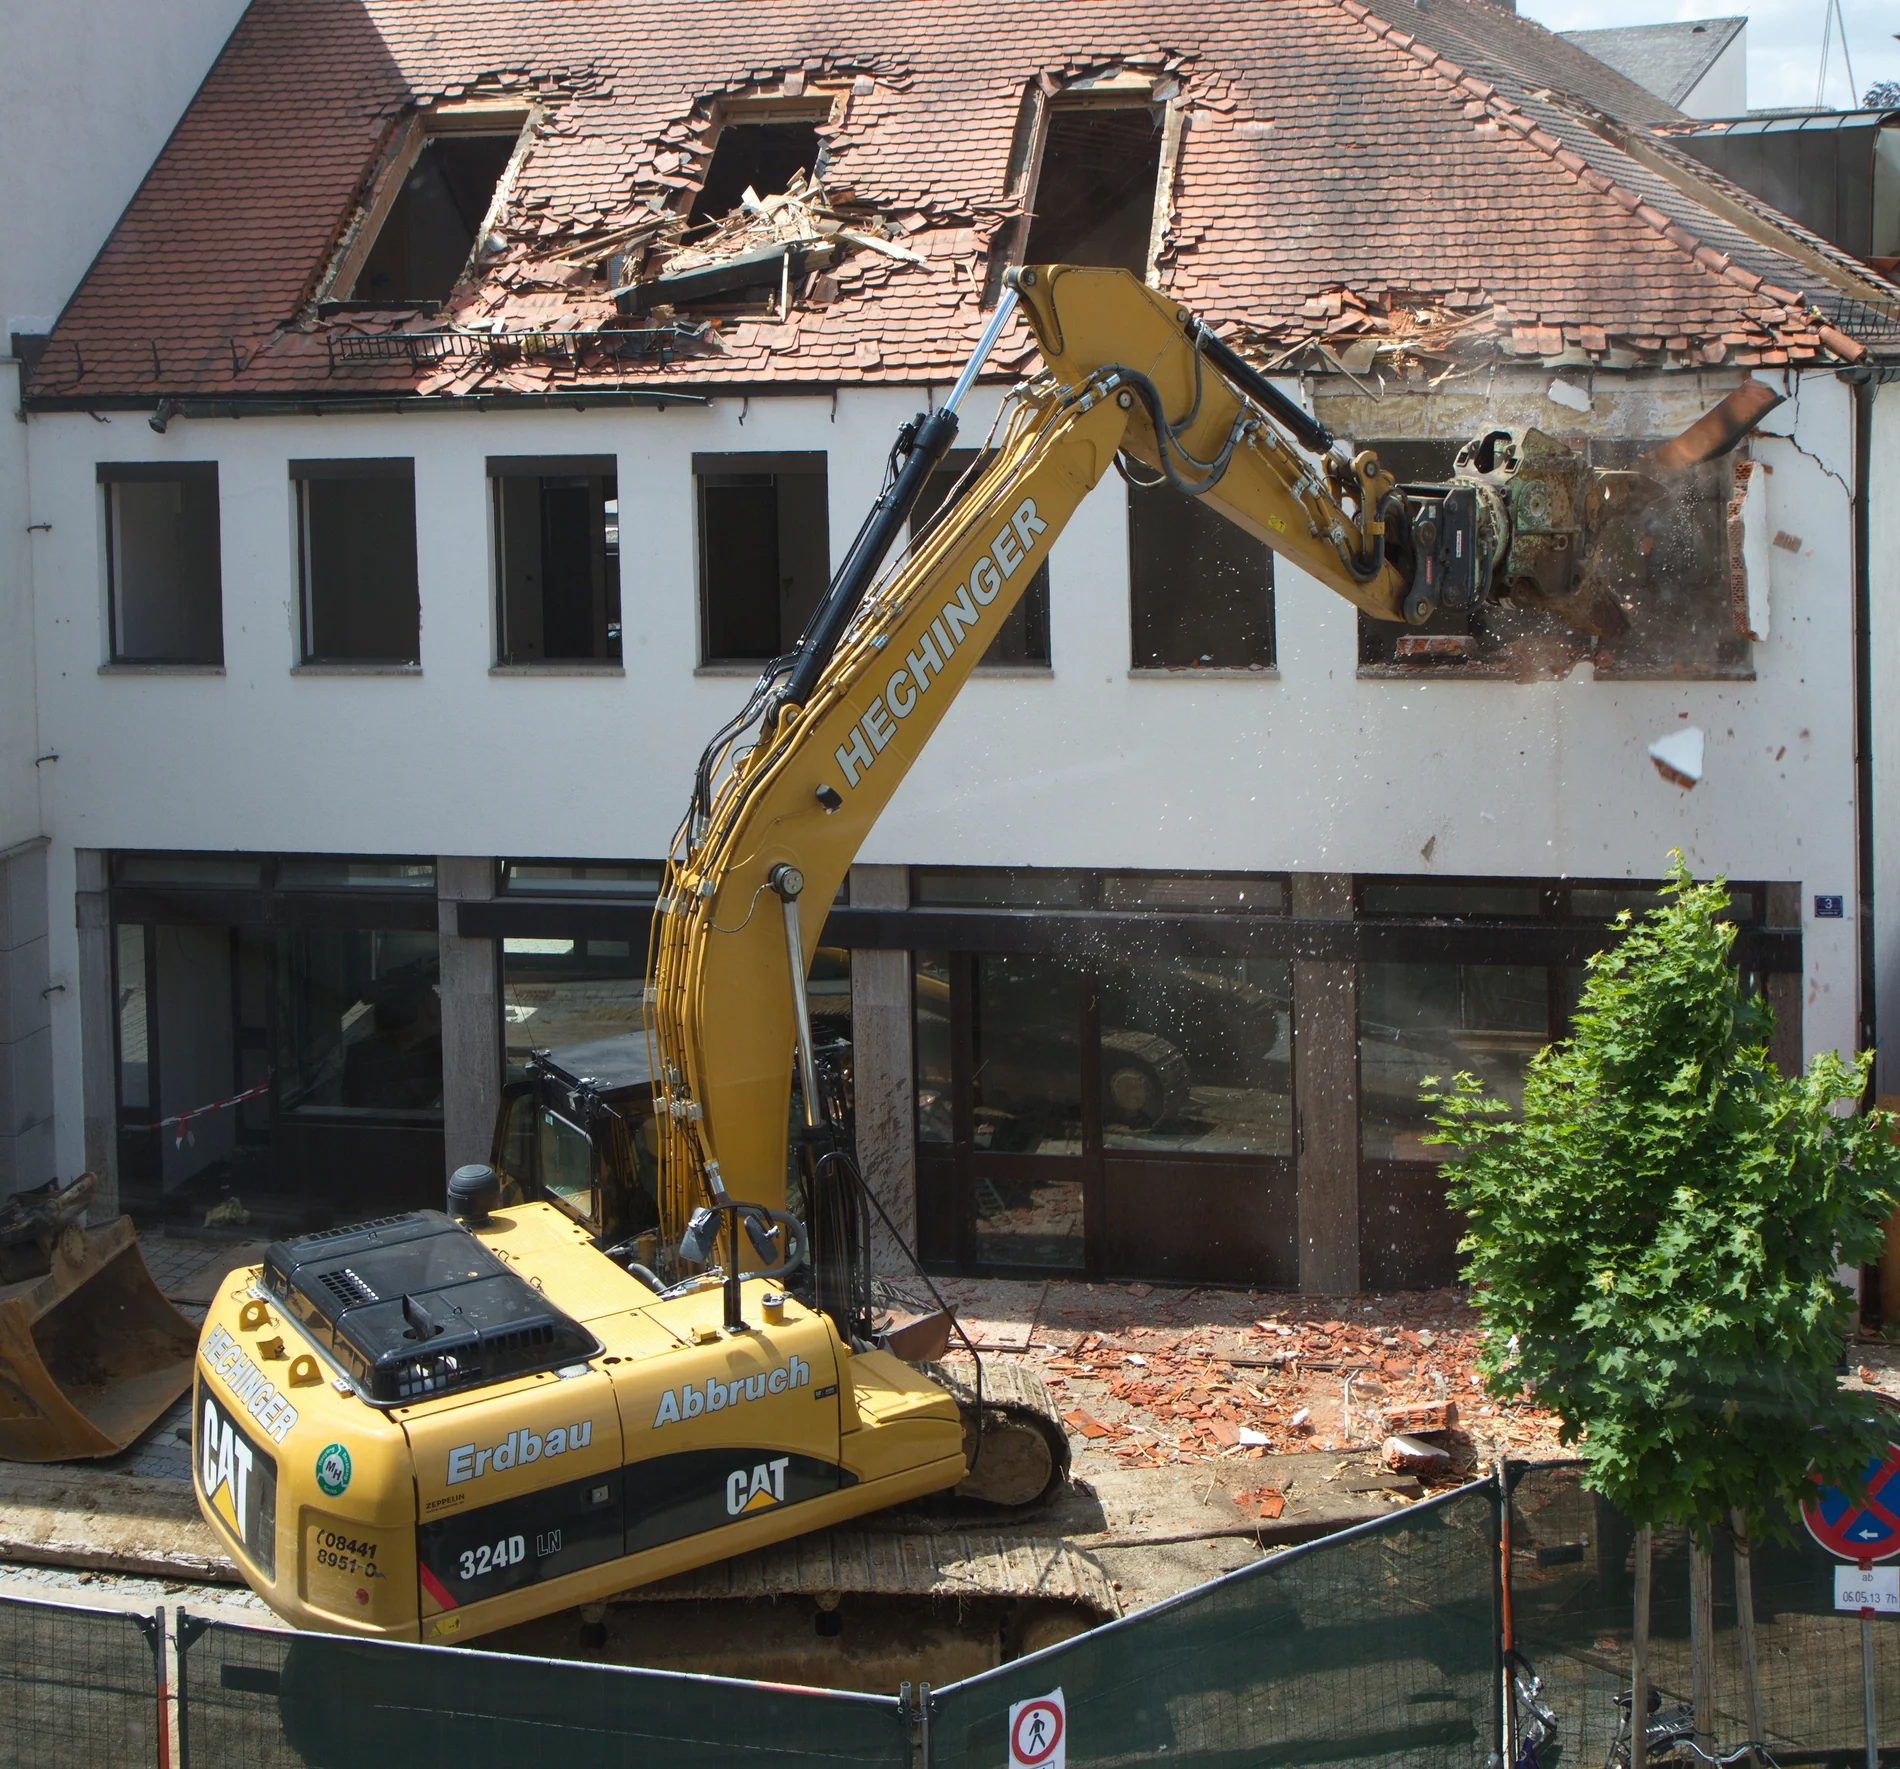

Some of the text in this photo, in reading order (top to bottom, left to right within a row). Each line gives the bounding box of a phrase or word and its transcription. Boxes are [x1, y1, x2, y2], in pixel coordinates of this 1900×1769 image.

[834, 497, 1049, 789] HECHINGER
[1825, 898, 1833, 909] 3
[200, 1323, 298, 1443] HECHINGER
[652, 1355, 810, 1429] Abbruch
[203, 1399, 253, 1543] CAT
[446, 1420, 592, 1486] Erdbau
[425, 1493, 465, 1509] ZEPPELIN
[726, 1457, 789, 1515] CAT
[459, 1529, 562, 1580] 324D LN
[1861, 1573, 1874, 1582] ab
[1842, 1591, 1898, 1604] 06.05.13 7h
